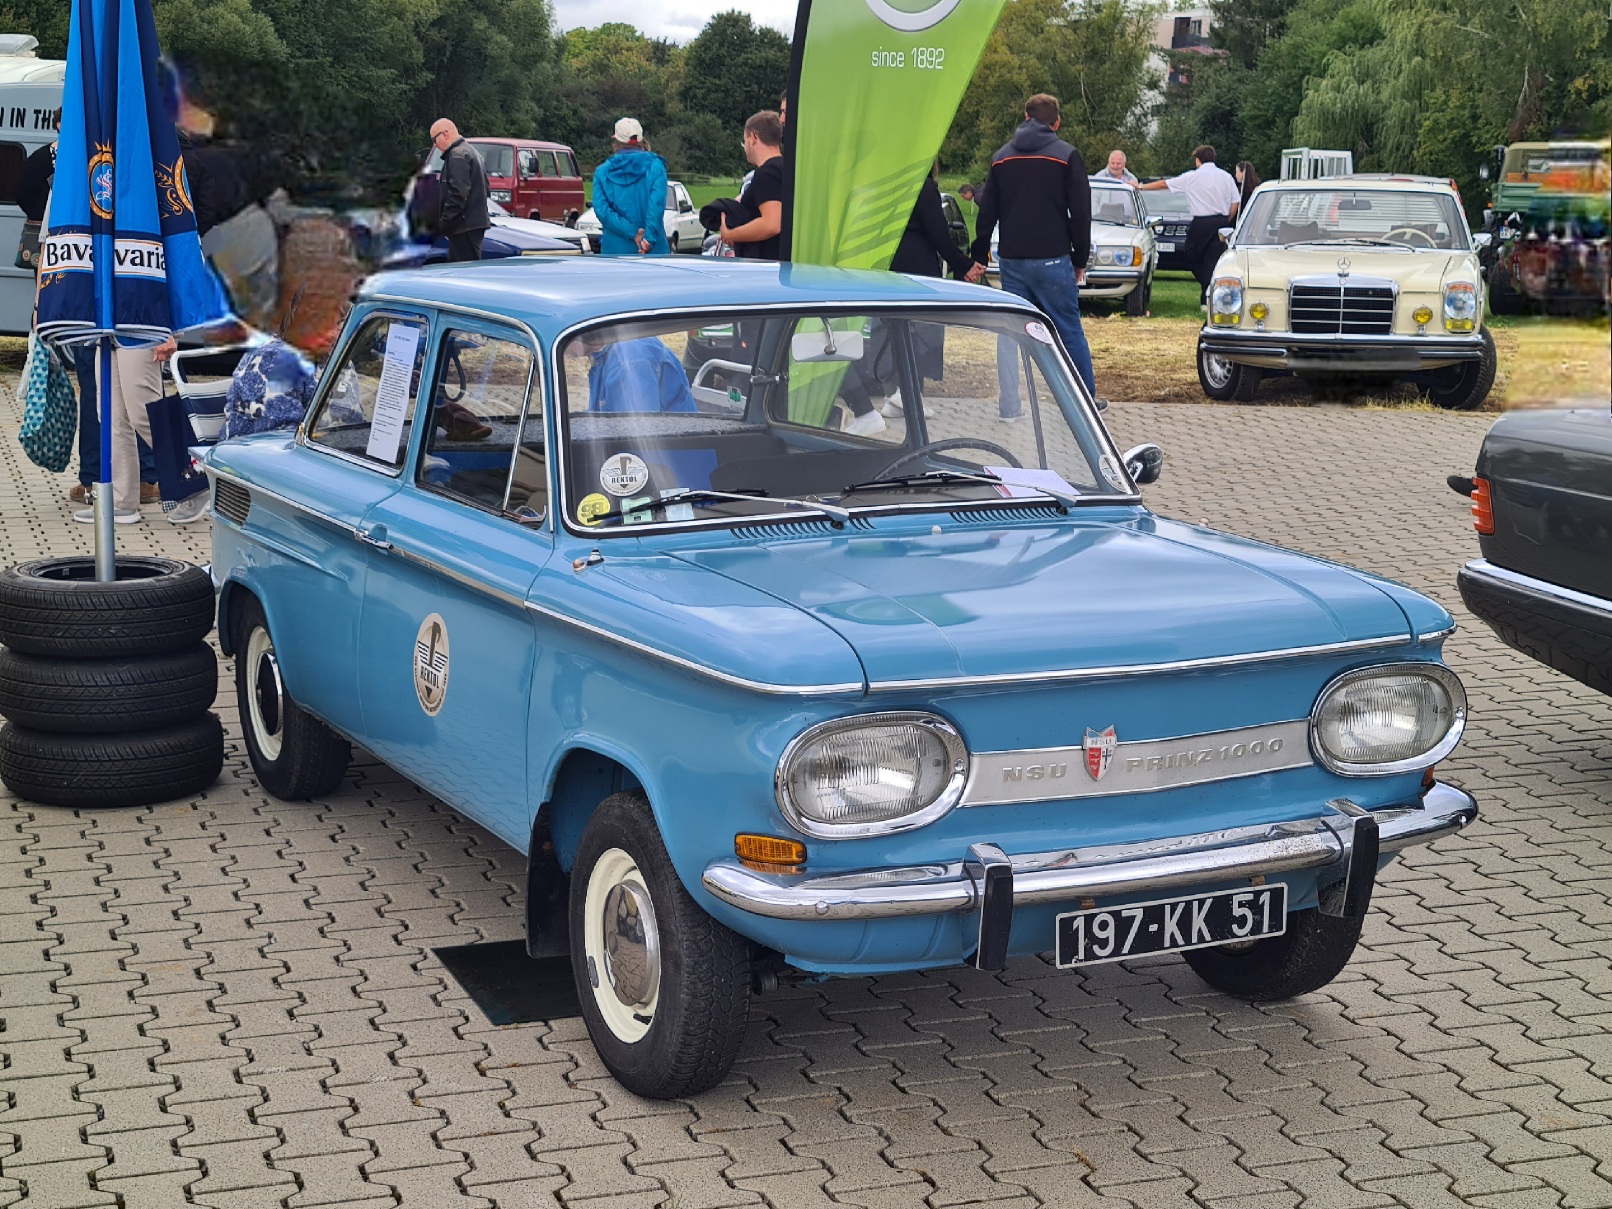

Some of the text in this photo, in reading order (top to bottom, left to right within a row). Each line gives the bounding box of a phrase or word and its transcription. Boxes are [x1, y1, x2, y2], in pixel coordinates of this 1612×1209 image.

[871, 46, 945, 69] since 1892
[9, 107, 26, 128] IN
[33, 109, 58, 130] TH
[1091, 738, 1112, 746] NSU
[1002, 737, 1284, 782] NSU PRINZ 1000
[1231, 891, 1272, 937] 51
